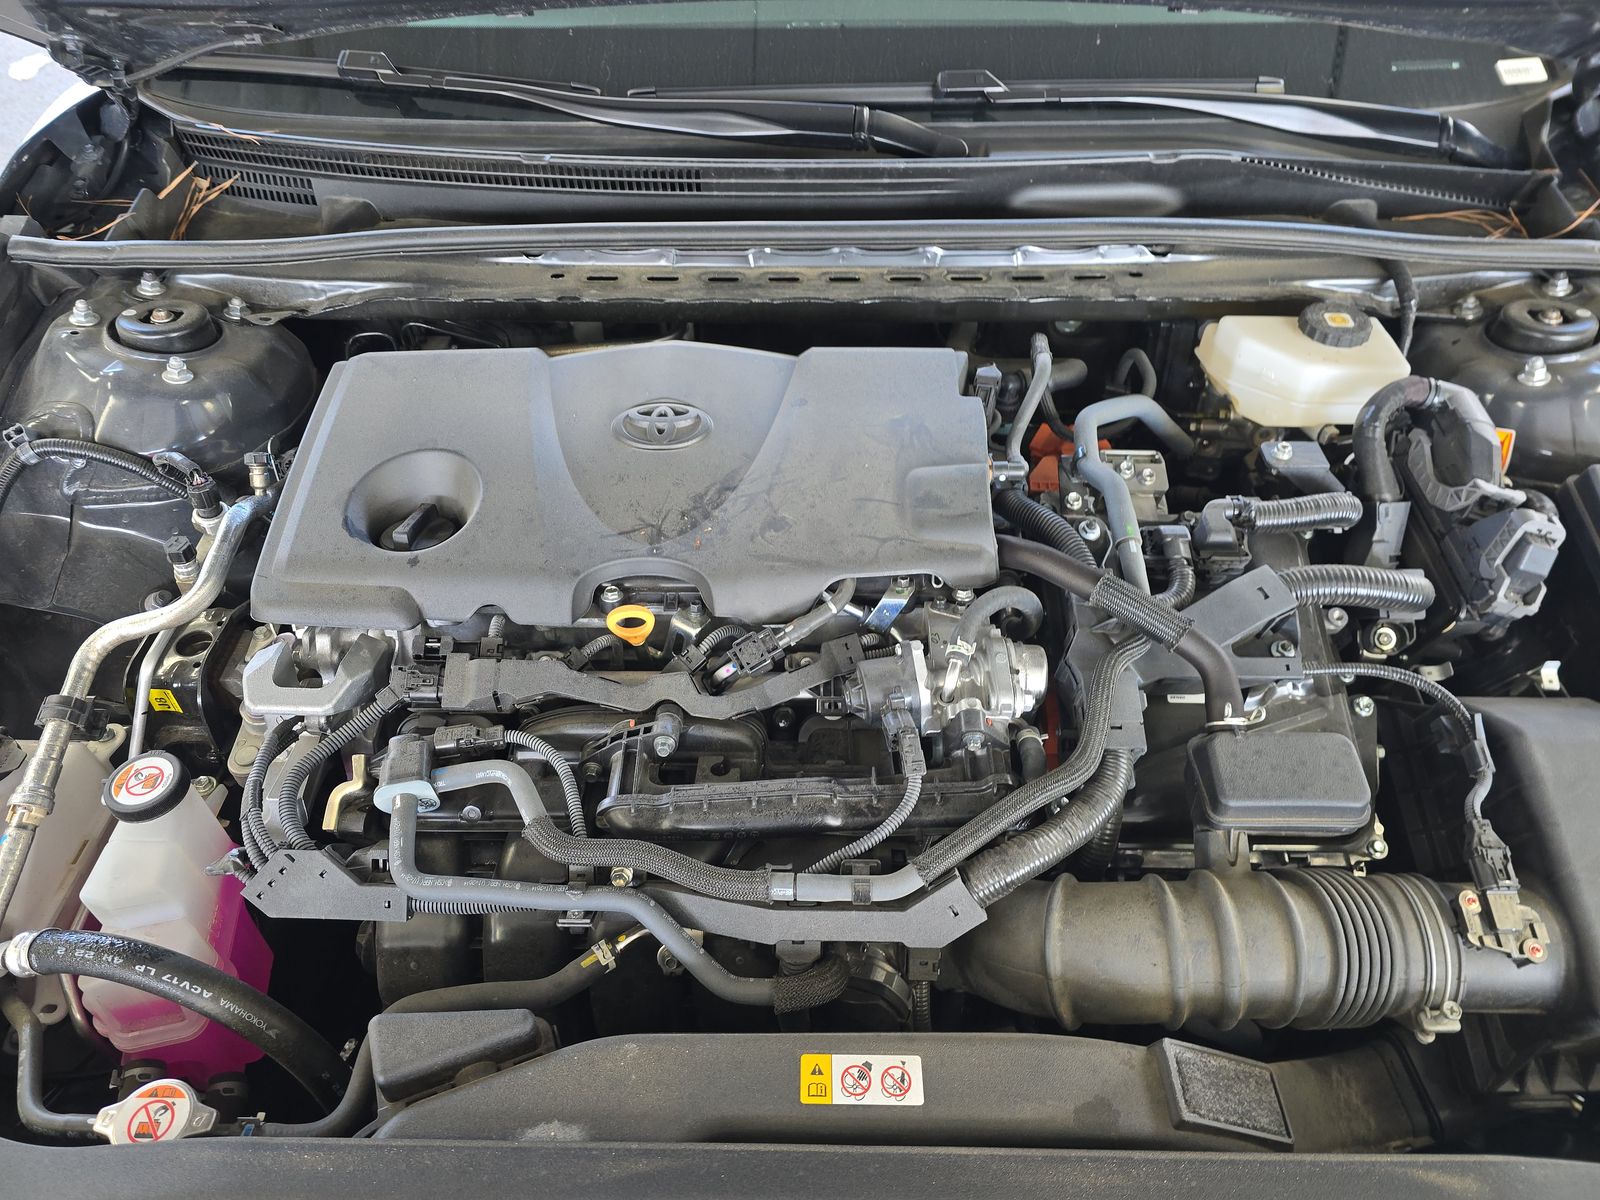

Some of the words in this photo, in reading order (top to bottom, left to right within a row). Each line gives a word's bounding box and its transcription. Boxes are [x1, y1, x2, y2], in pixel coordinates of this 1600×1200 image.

[154, 697, 171, 709] J8
[74, 949, 96, 959] 22
[134, 963, 156, 976] LP
[161, 972, 213, 999] ACV17
[219, 998, 268, 1031] YOKOHAMA
